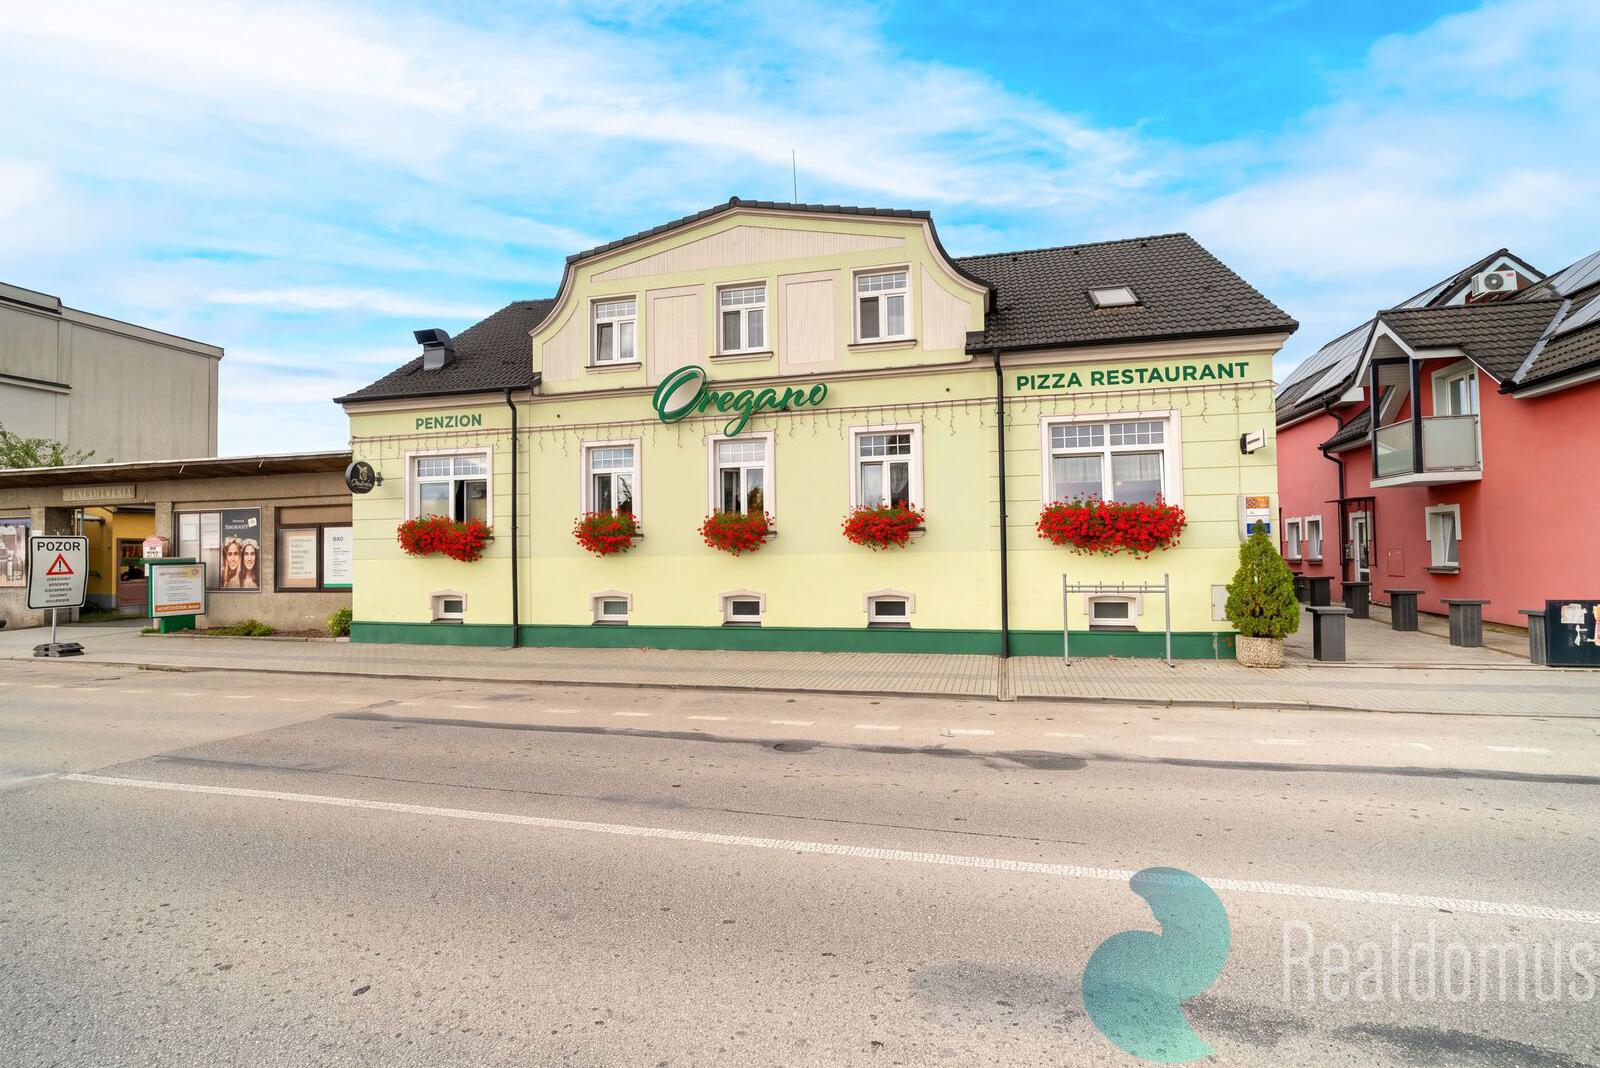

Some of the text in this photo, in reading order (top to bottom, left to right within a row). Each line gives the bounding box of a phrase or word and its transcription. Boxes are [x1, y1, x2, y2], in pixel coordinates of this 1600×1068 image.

[1016, 361, 1249, 391] PIZZA RESTAURANT
[652, 365, 828, 437] Oregano
[415, 413, 482, 430] PENZION
[37, 541, 81, 552] POZOR
